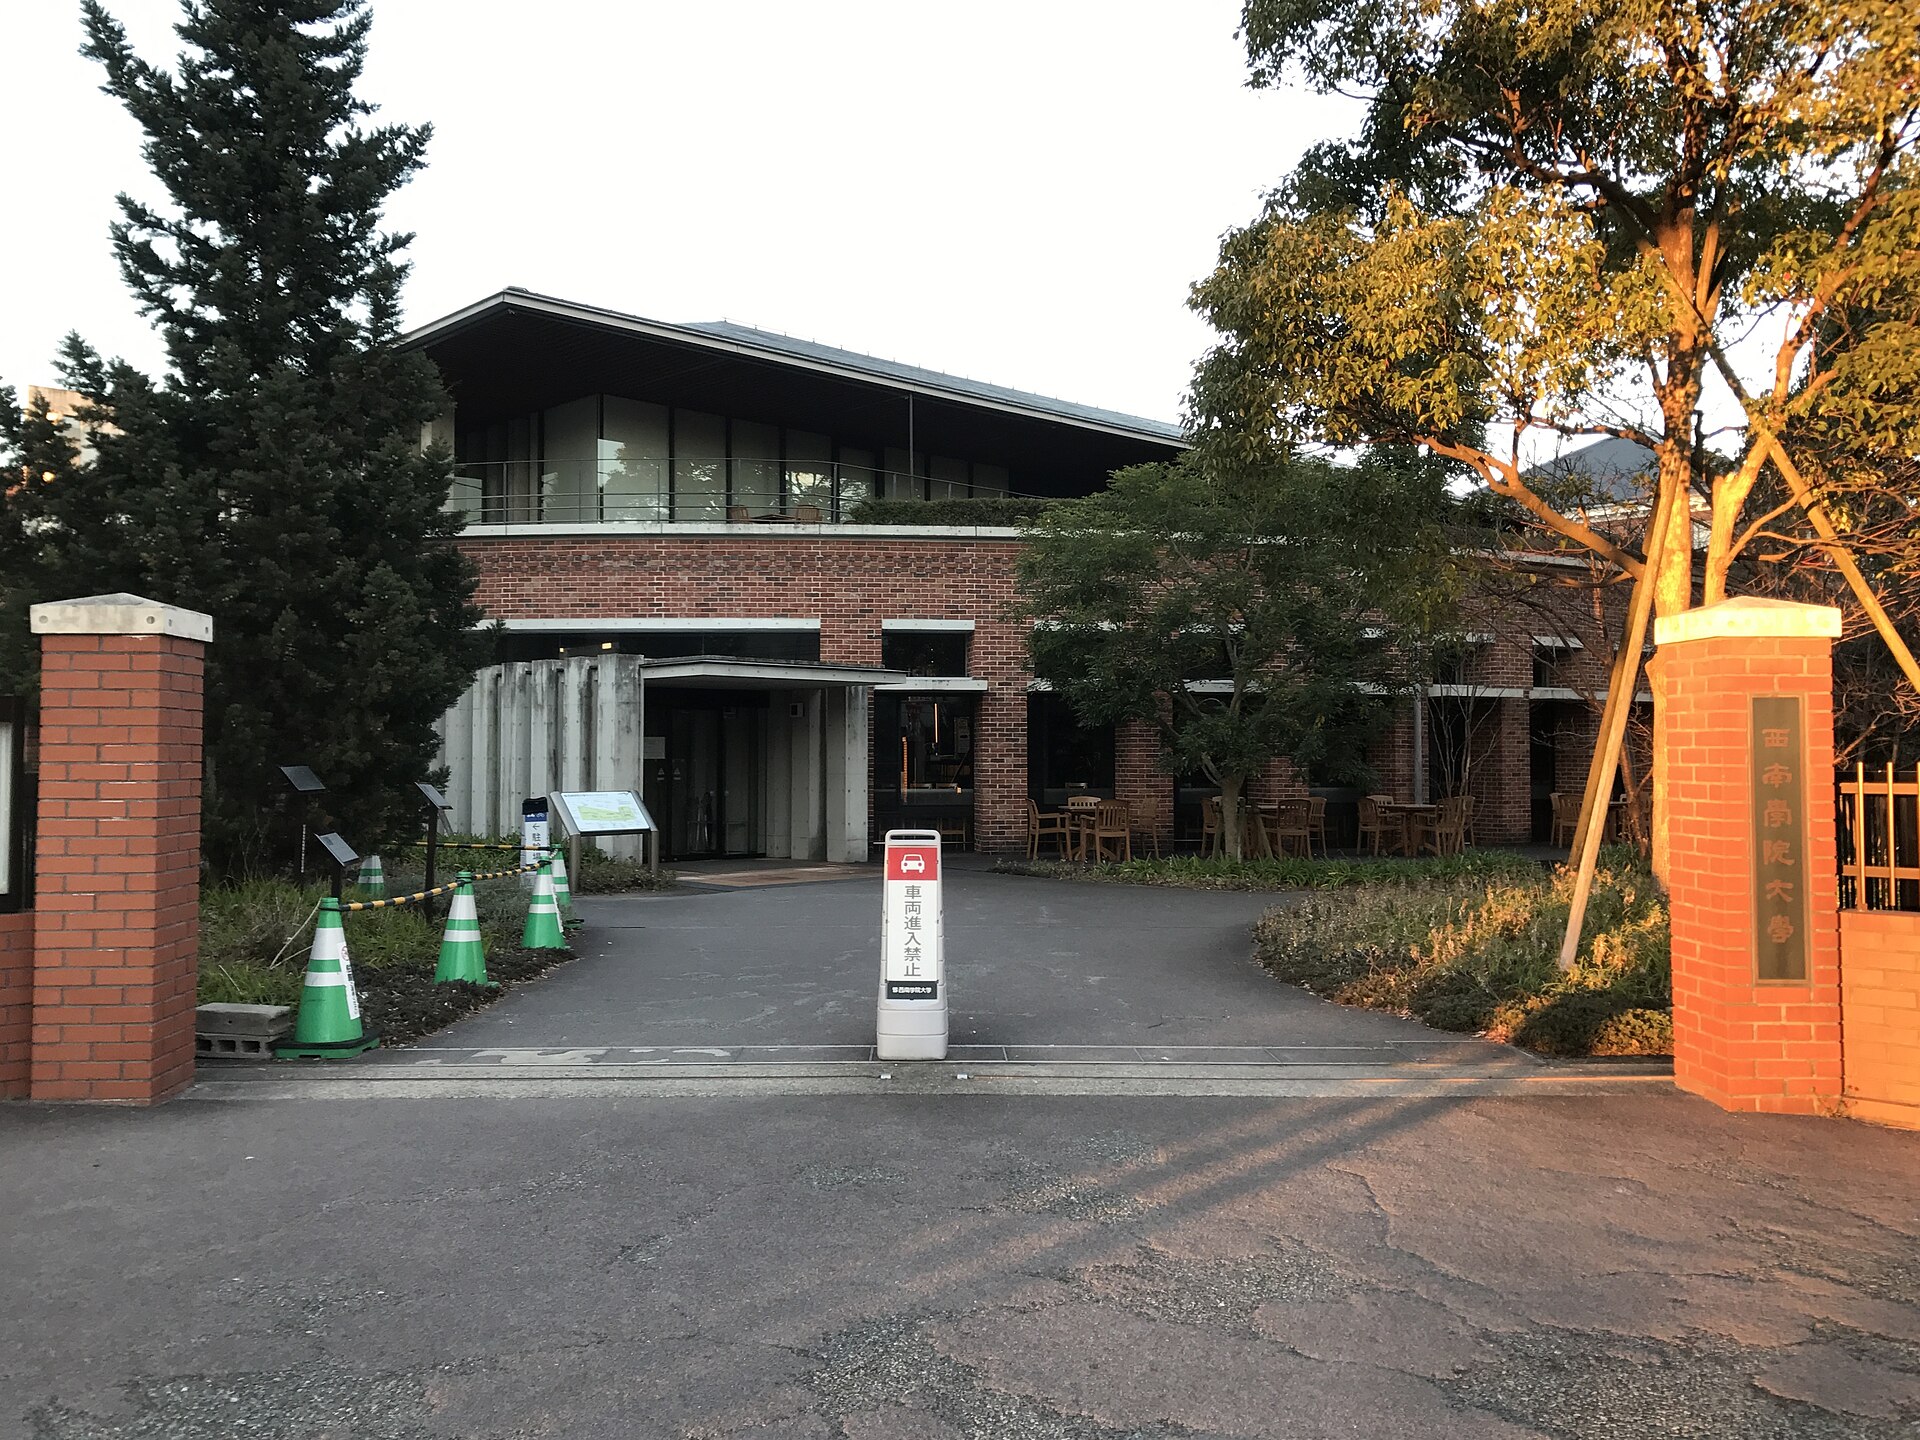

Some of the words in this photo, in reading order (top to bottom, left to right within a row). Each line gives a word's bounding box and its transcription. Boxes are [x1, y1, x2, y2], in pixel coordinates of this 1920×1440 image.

[904, 885, 921, 977] 車両進入禁止
